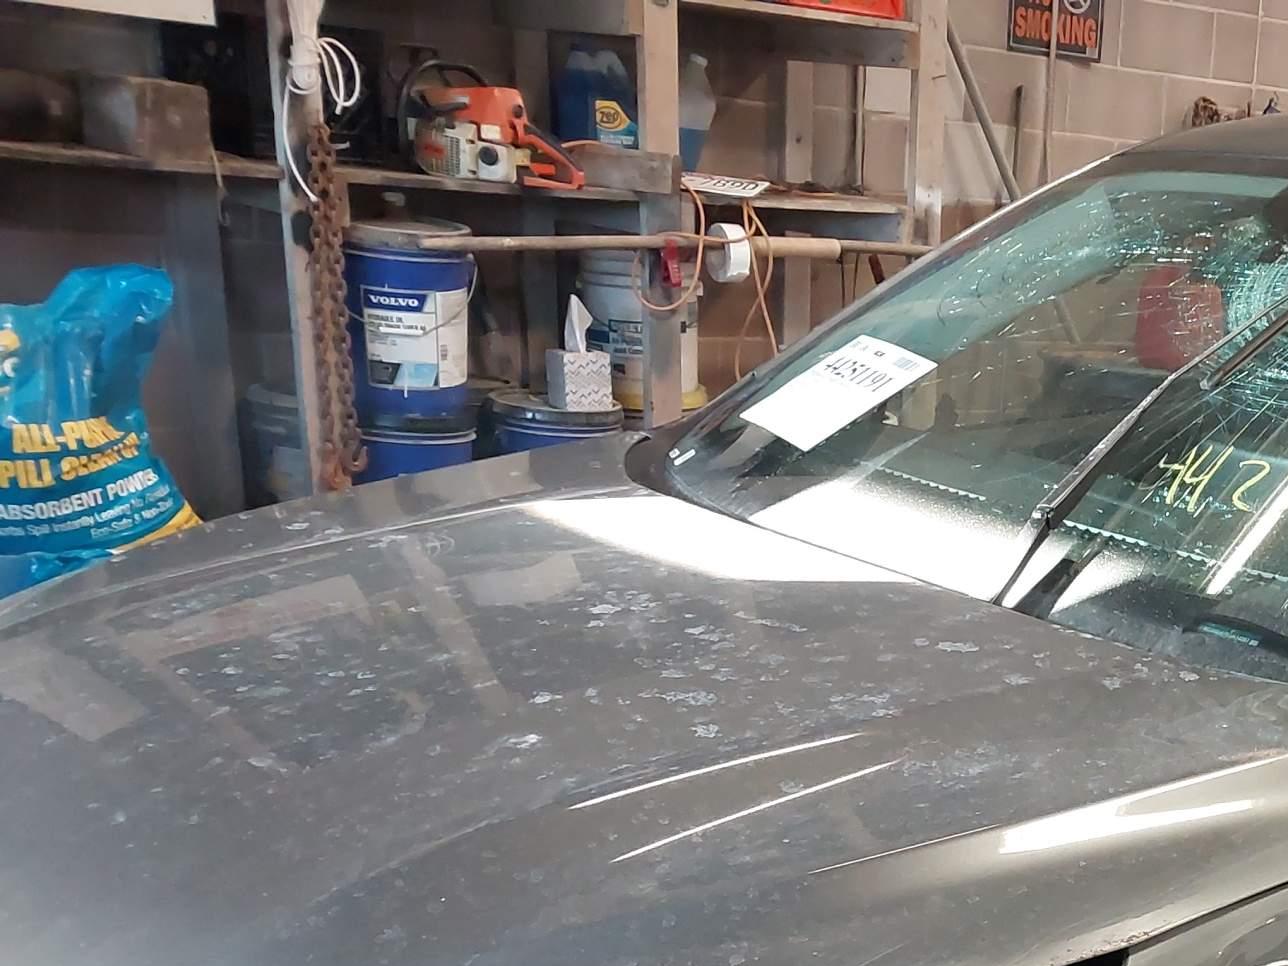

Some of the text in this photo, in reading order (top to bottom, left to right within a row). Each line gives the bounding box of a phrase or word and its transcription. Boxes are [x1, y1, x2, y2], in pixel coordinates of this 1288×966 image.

[1014, 6, 1097, 48] SMOKING
[368, 294, 420, 307] VOLVO
[0, 459, 56, 489] PILL
[0, 488, 104, 520] ABSORBENT
